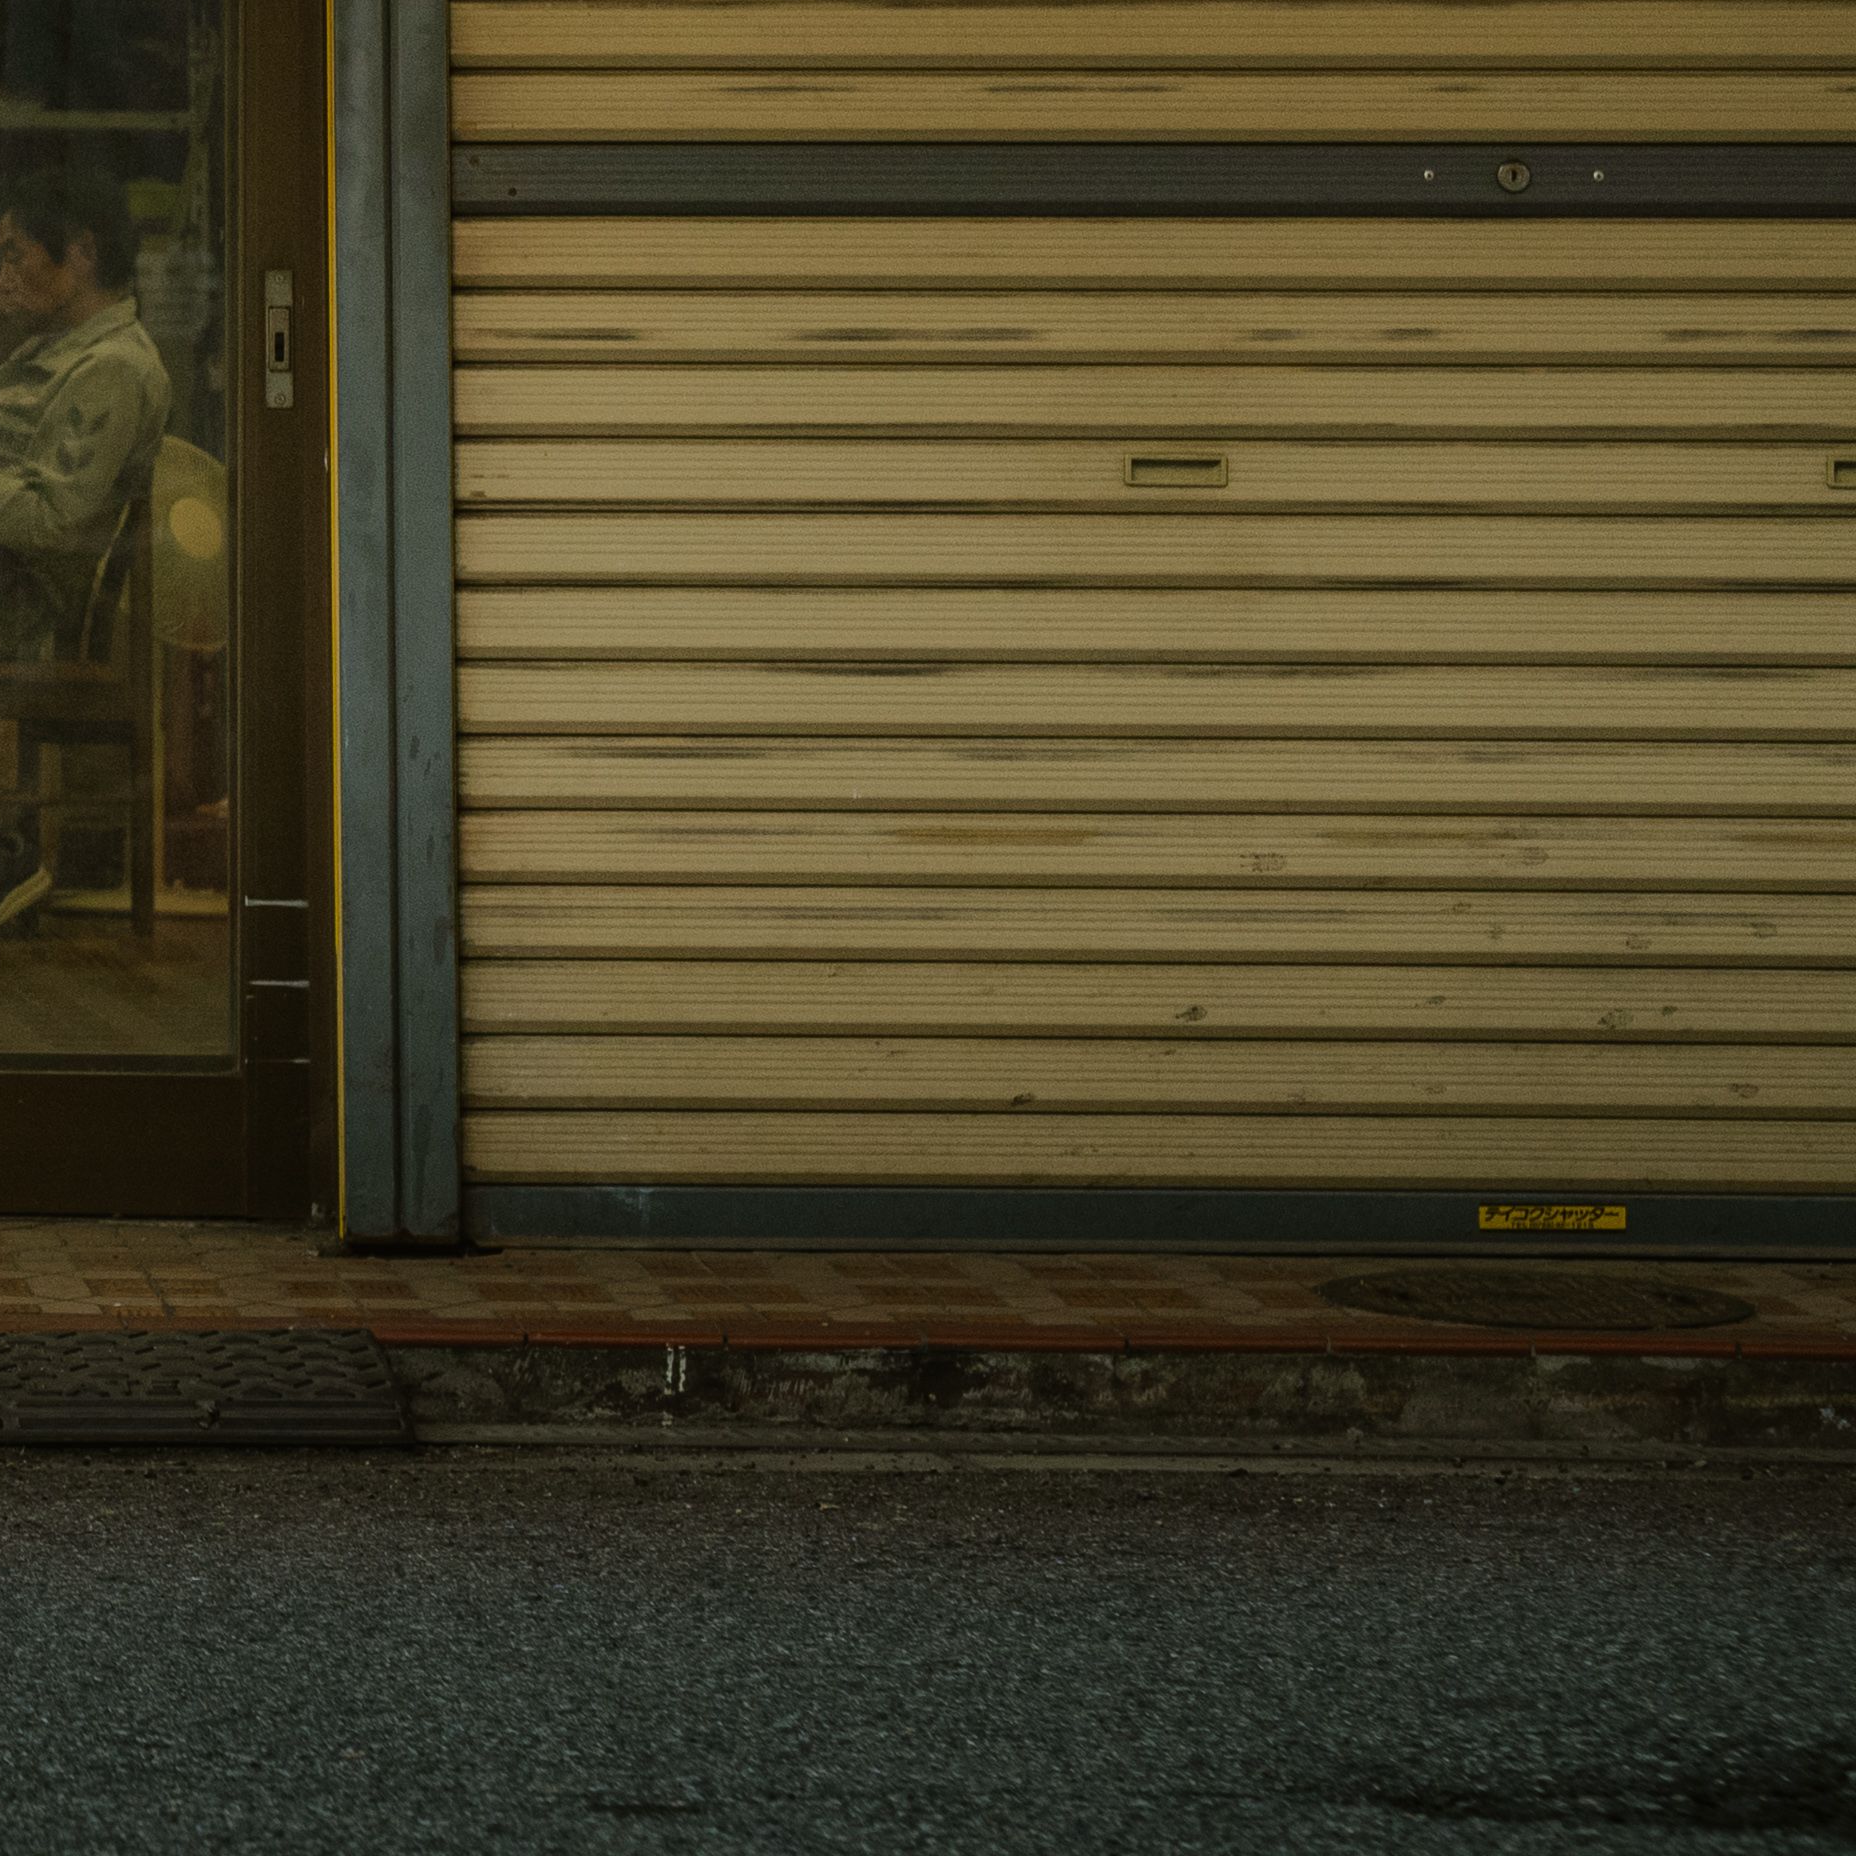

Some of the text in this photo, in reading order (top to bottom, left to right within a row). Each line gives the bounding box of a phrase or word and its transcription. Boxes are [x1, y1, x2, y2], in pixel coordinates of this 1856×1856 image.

[1485, 1206, 1619, 1222] テイコクシャッター
